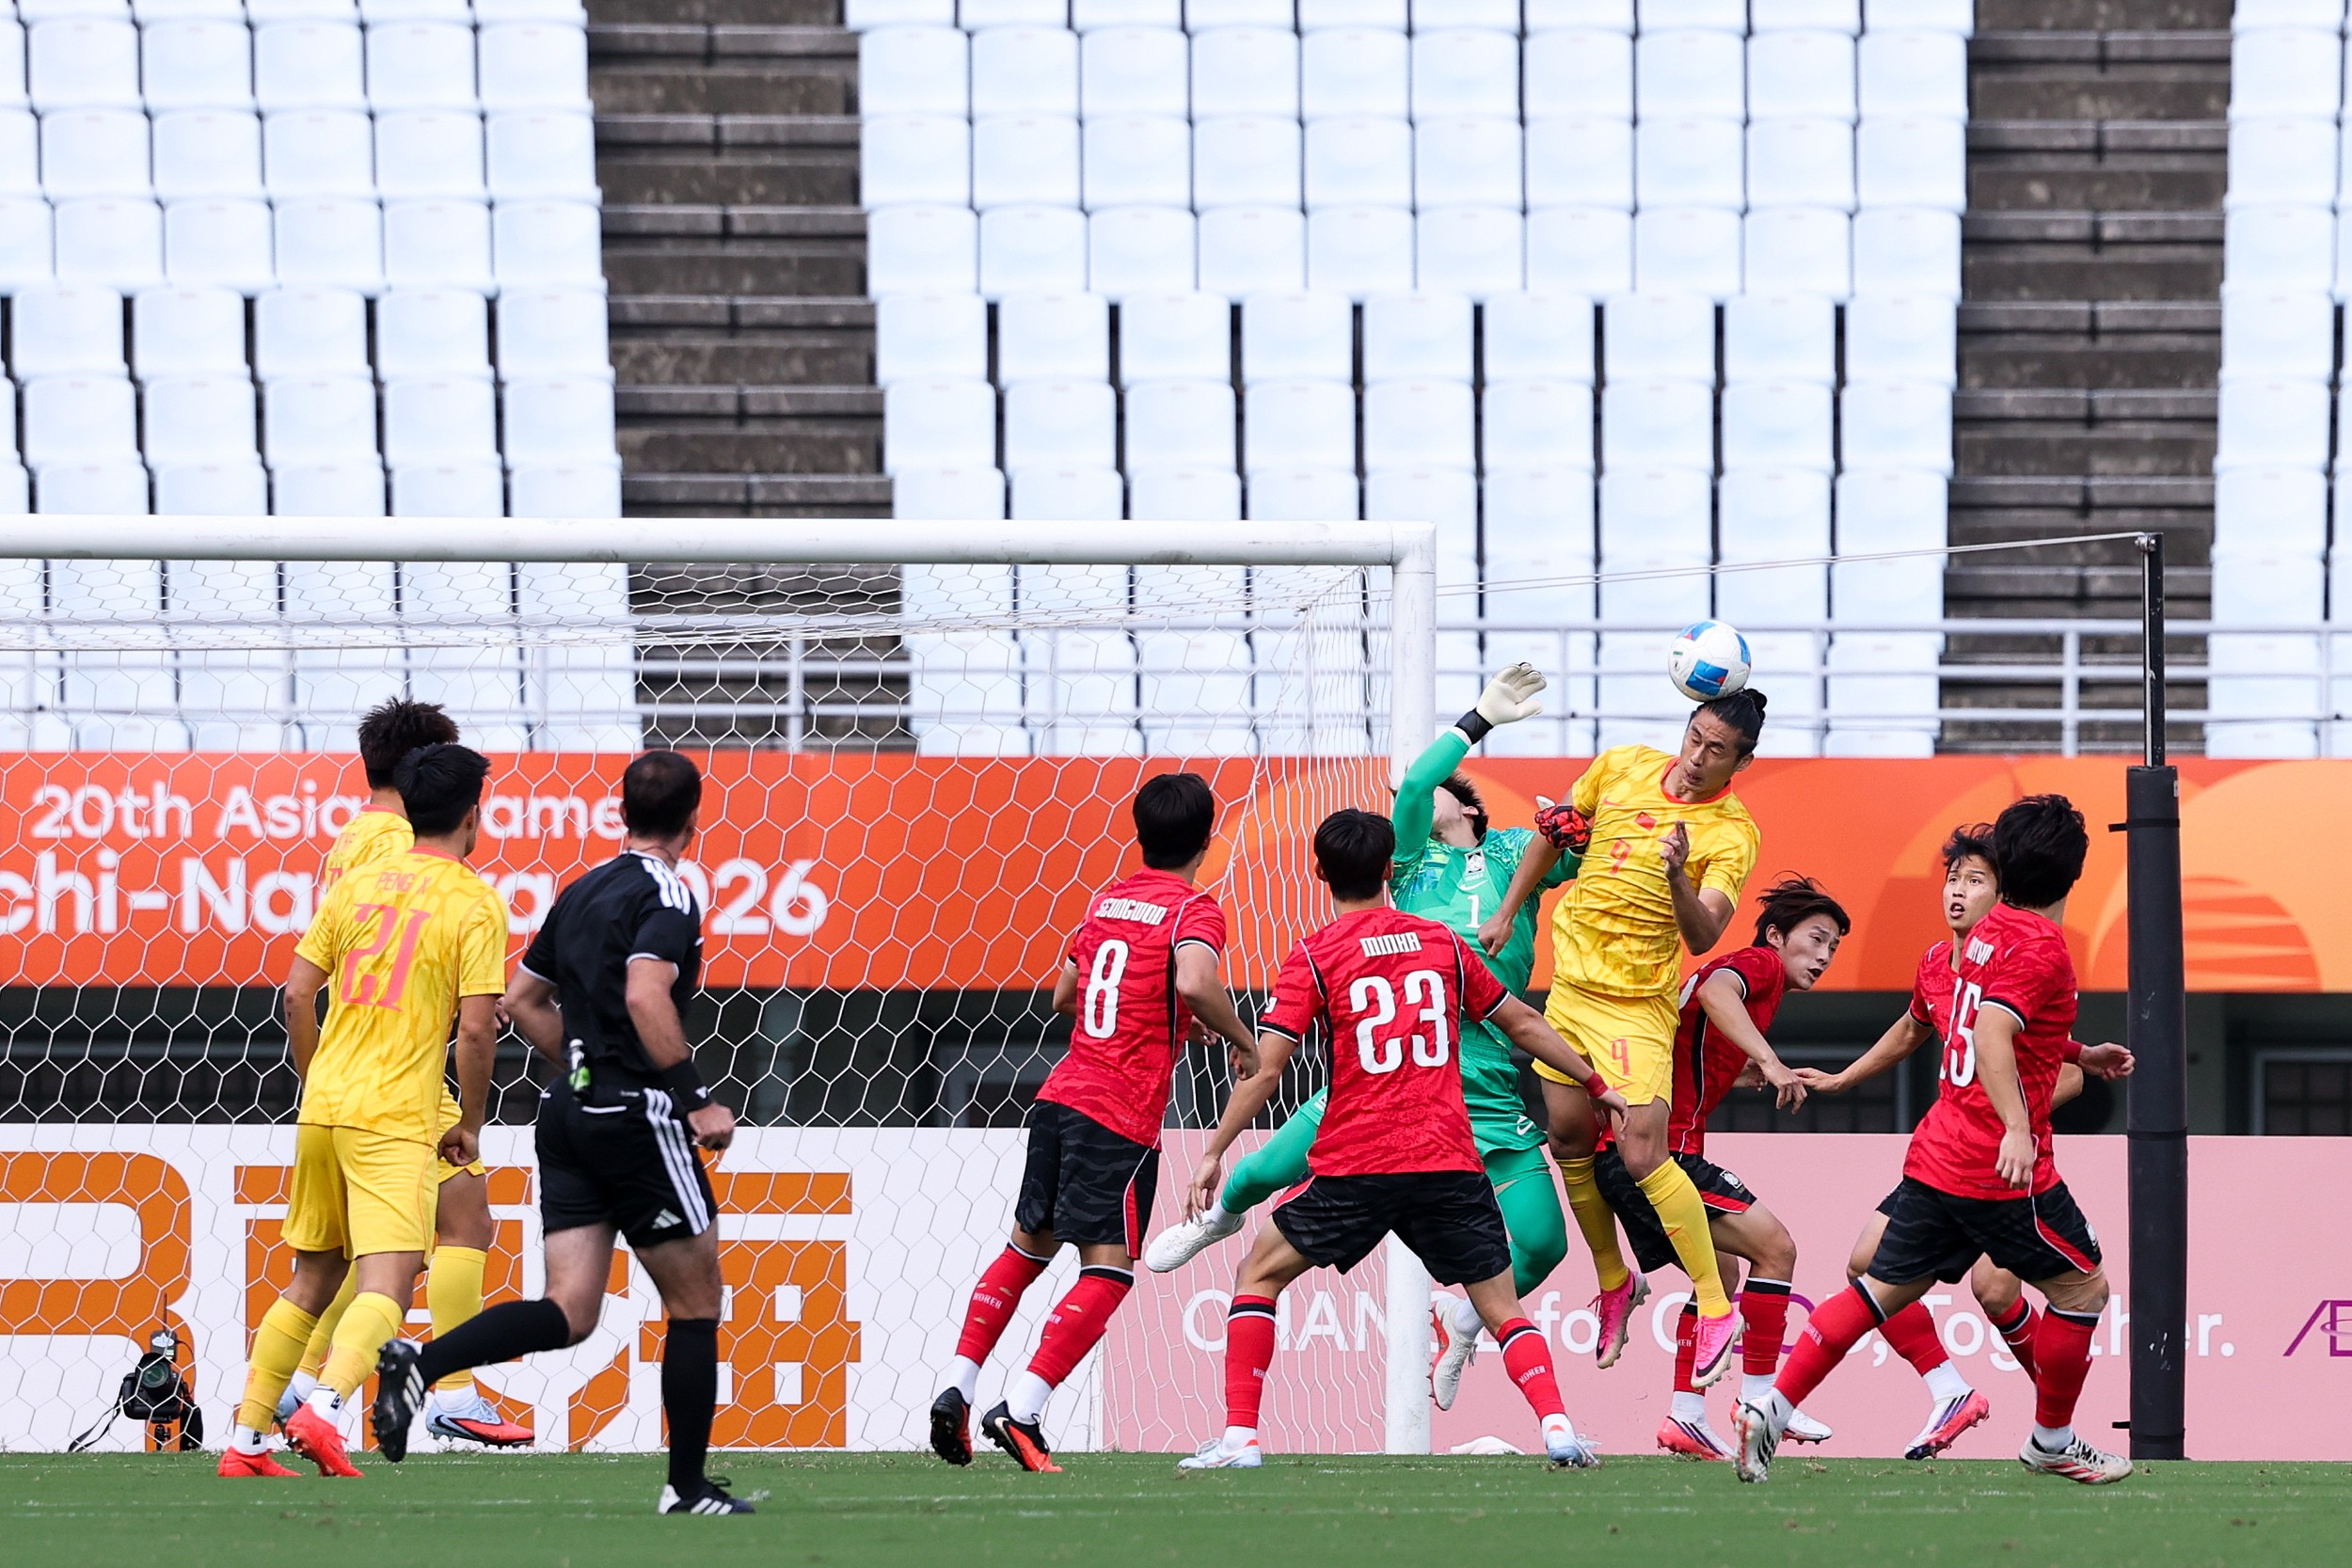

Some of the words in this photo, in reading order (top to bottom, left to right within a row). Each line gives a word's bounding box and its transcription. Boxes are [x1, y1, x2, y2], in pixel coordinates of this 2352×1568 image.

[31, 781, 193, 839] 20th
[215, 779, 371, 839] Asia
[479, 795, 628, 840] ame
[1610, 840, 1631, 874] 9
[375, 871, 414, 892] PENG
[1094, 897, 1168, 926] SEUNGWON
[1466, 895, 1481, 929] 1
[342, 903, 432, 1012] 21
[1359, 932, 1422, 958] MINHA
[1085, 939, 1129, 1039] 8
[1349, 970, 1450, 1074] 23
[1611, 1038, 1630, 1076] 9
[1534, 1291, 1600, 1354] fo
